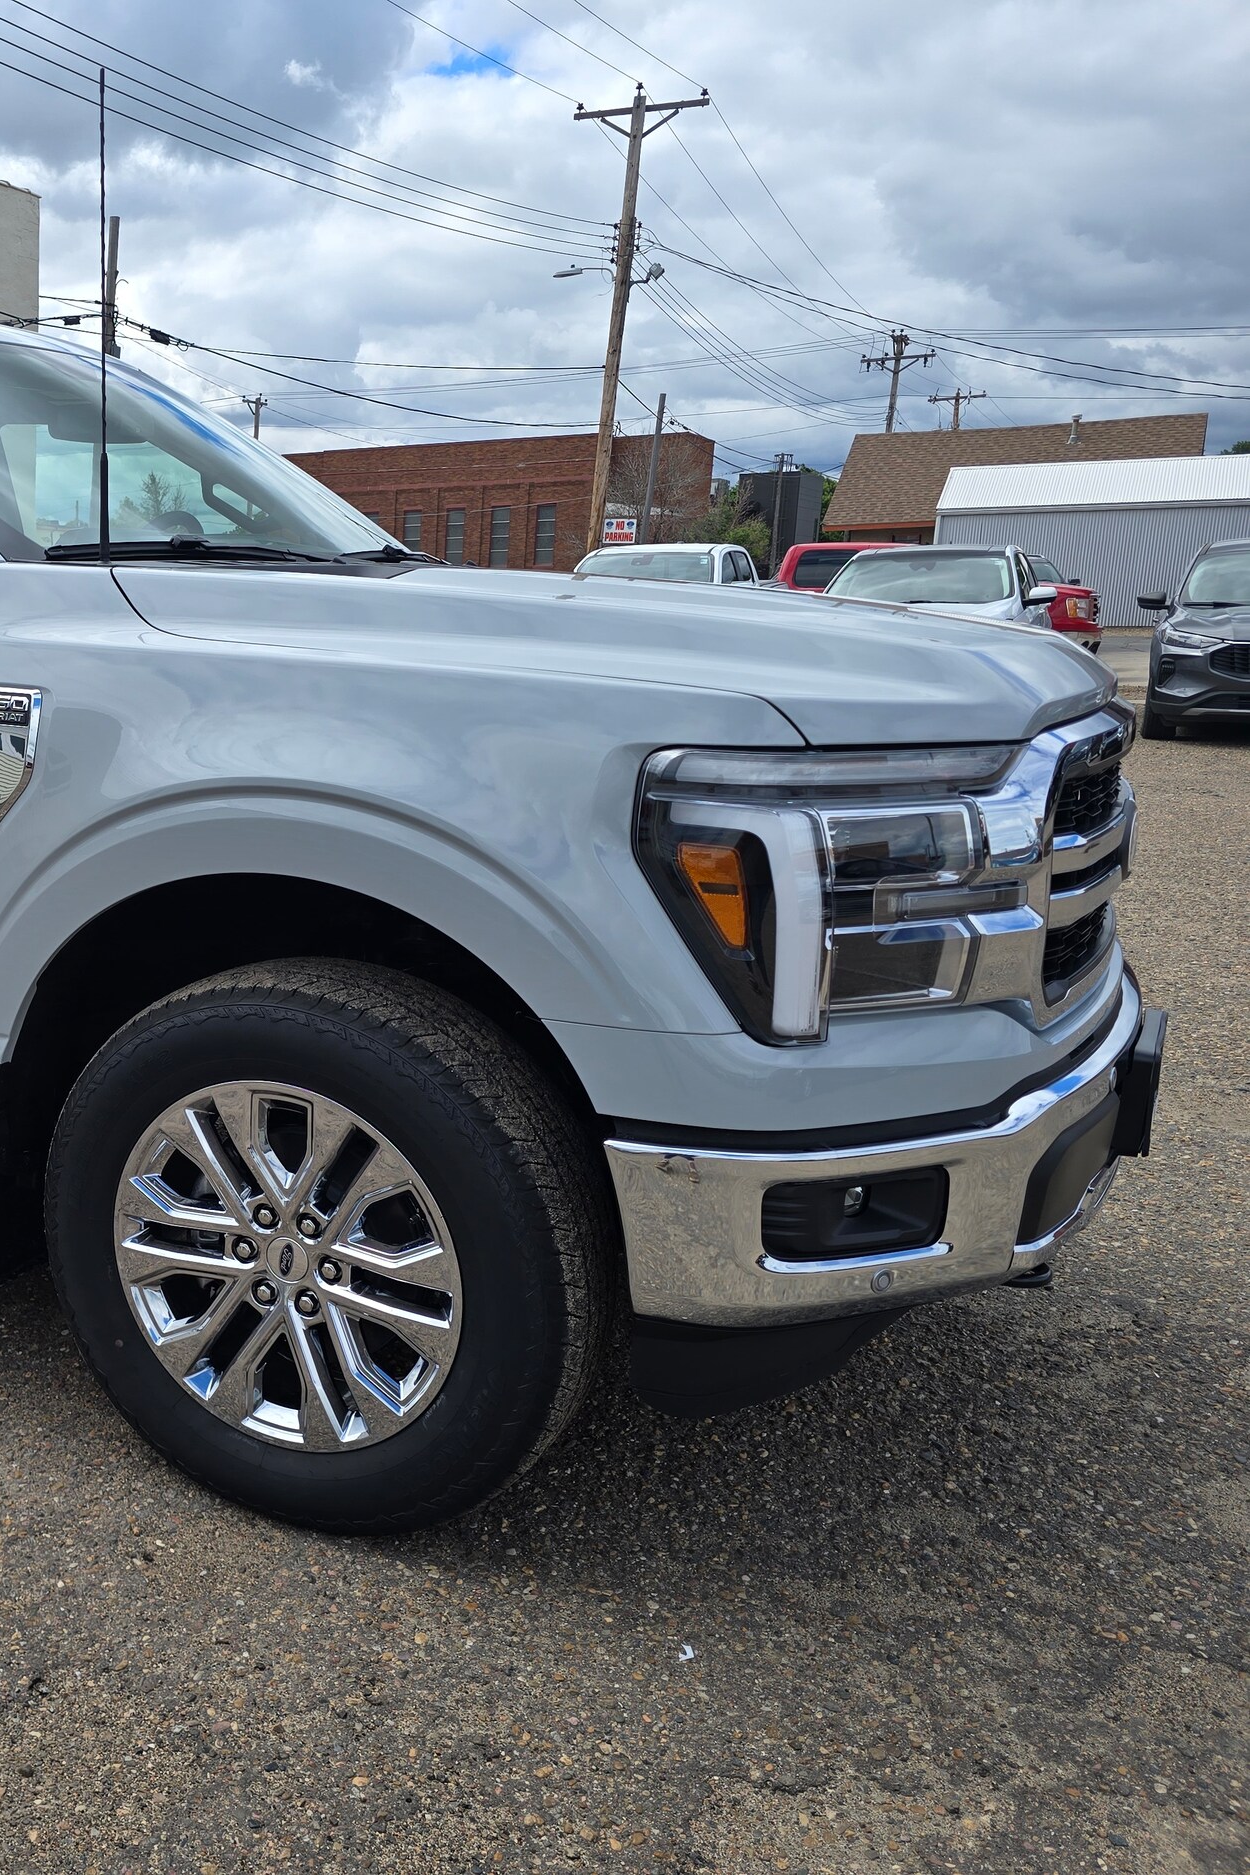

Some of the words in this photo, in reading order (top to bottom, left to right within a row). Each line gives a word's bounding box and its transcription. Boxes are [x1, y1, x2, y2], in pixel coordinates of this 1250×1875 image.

[615, 520, 625, 531] NO
[604, 531, 634, 542] PARKING
[280, 1247, 293, 1273] Ford
